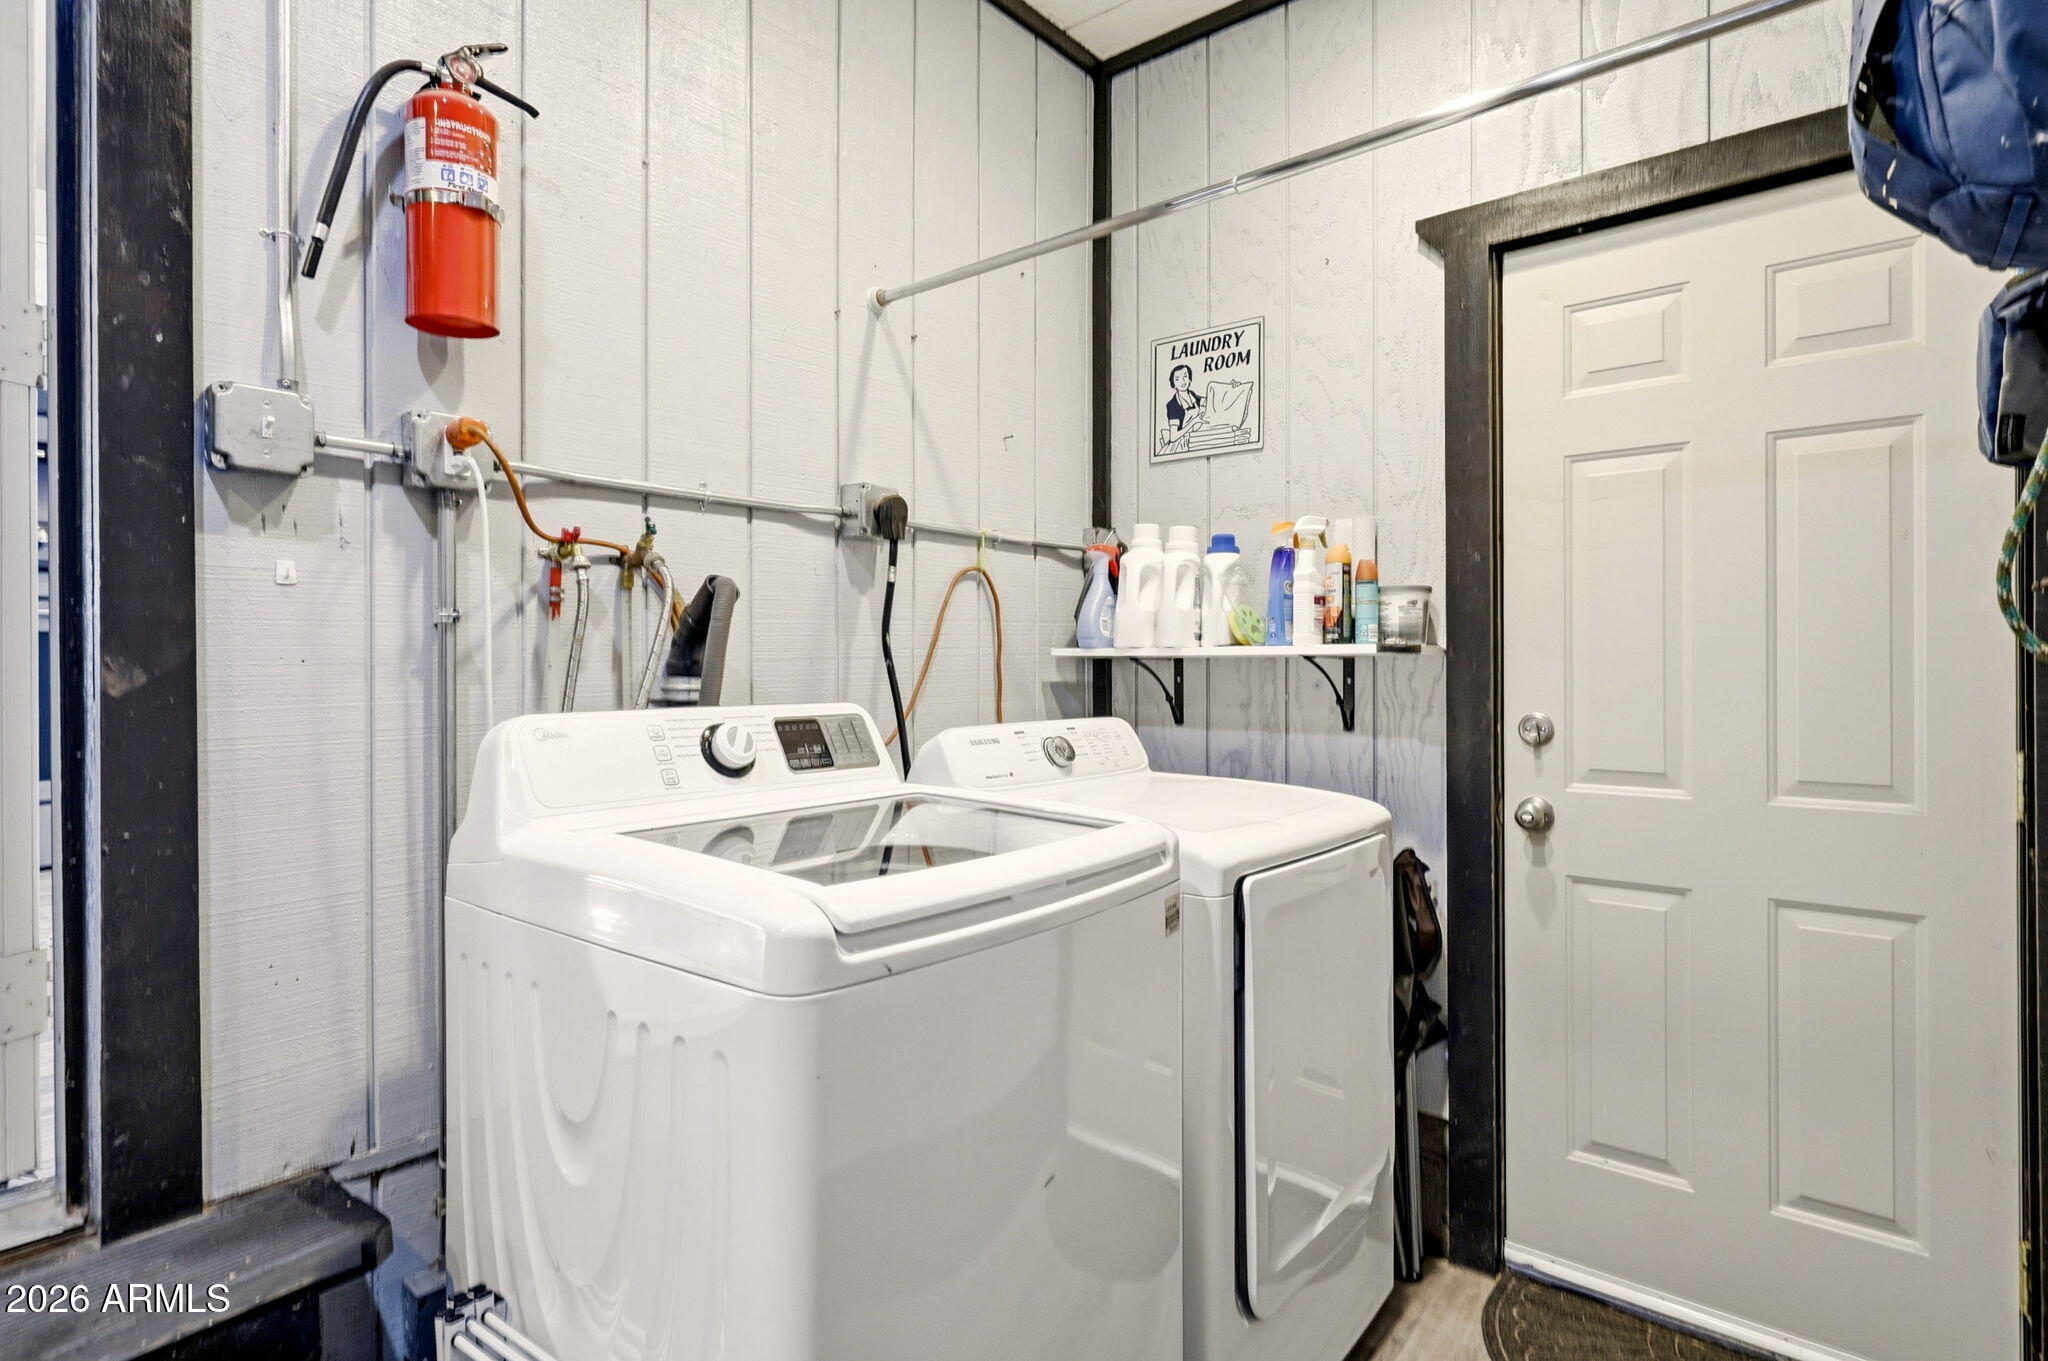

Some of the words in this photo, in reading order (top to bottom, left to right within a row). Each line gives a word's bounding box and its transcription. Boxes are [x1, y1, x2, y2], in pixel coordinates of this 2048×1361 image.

[1170, 330, 1245, 361] LAUNDRY
[1203, 349, 1252, 373] ROOM
[969, 738, 1001, 746] SAMSUNG
